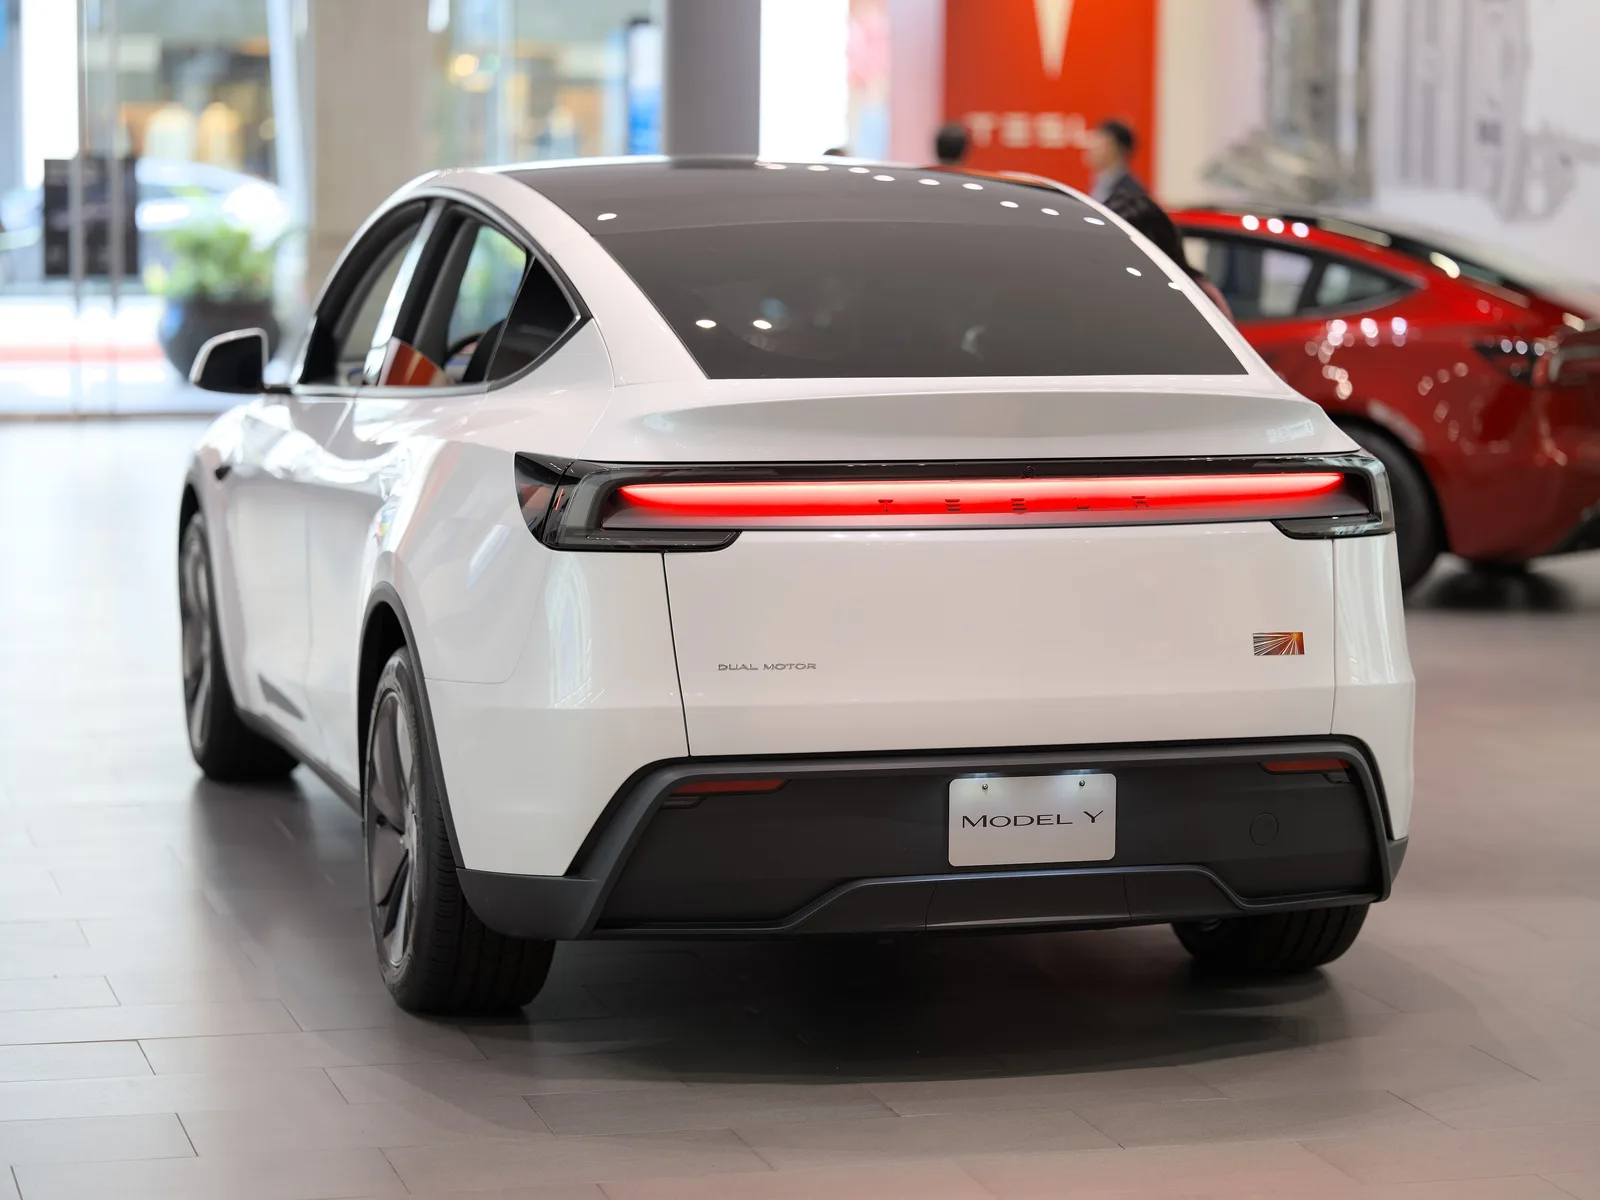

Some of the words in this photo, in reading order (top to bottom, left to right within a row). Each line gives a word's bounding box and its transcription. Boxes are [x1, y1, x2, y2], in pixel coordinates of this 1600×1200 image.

[962, 111, 1101, 149] TESL
[718, 663, 758, 671] DUAL
[962, 814, 1073, 828] MODEL
[1083, 810, 1104, 823] Y
